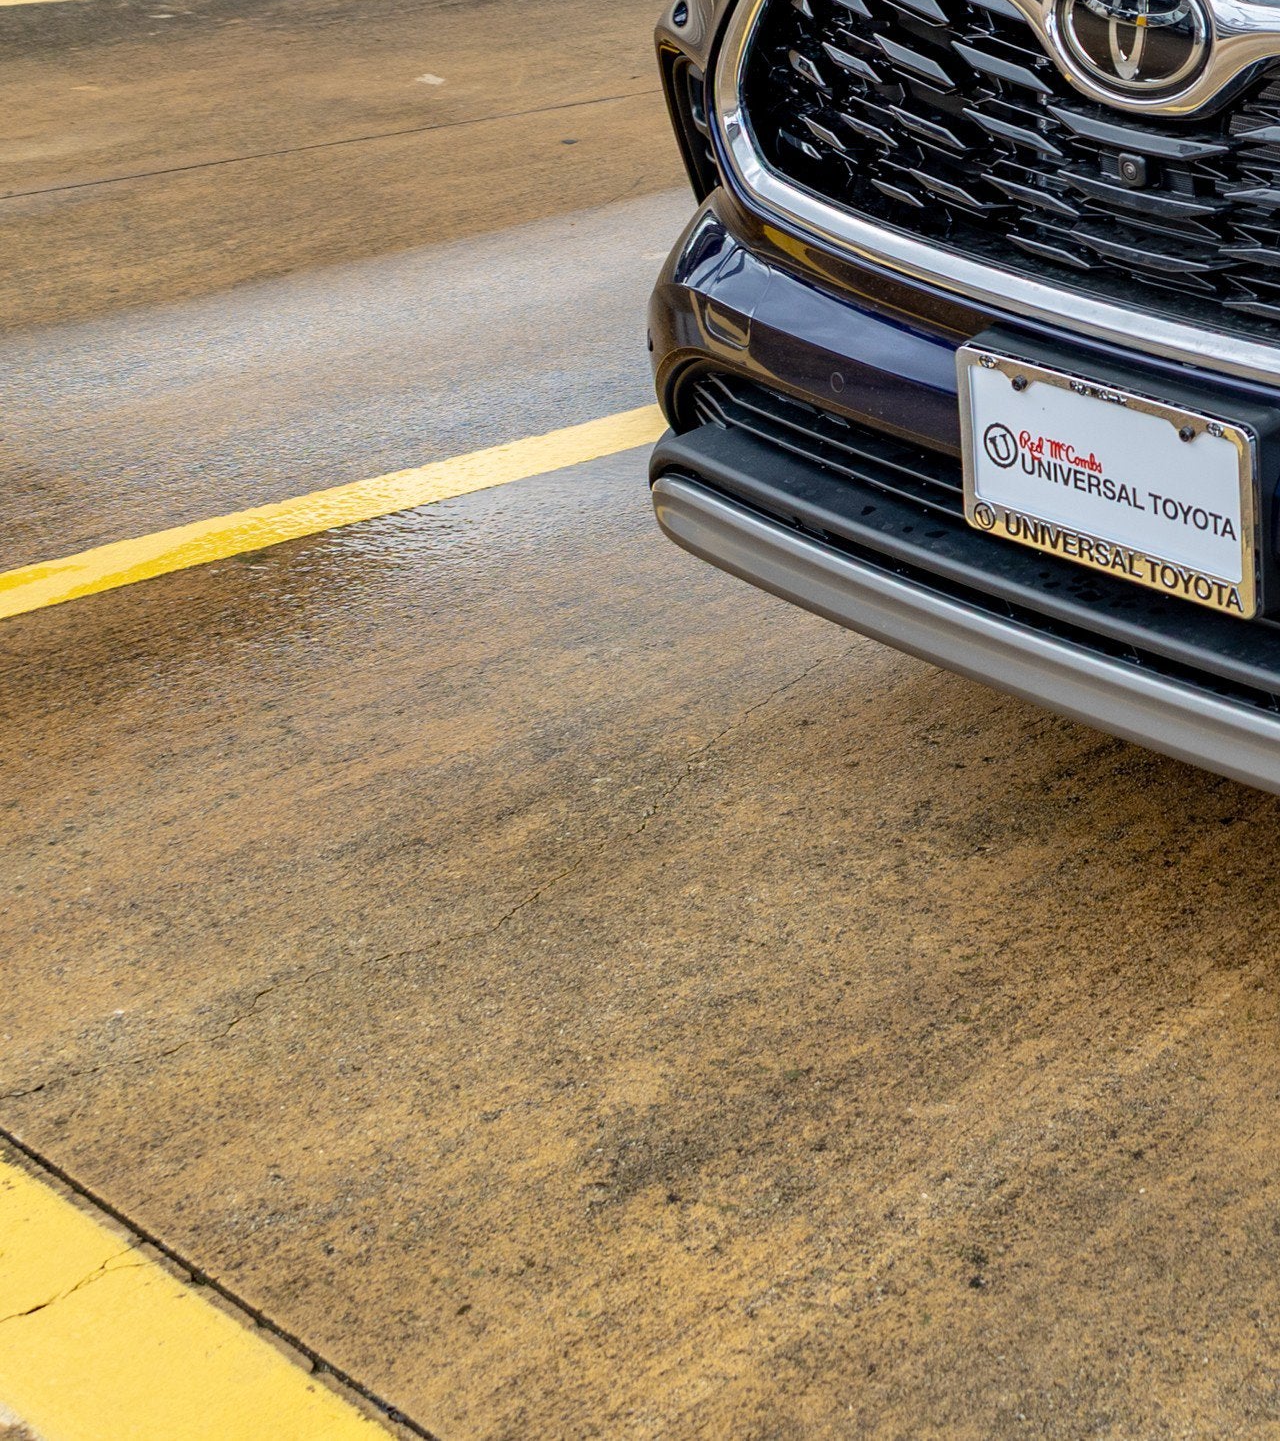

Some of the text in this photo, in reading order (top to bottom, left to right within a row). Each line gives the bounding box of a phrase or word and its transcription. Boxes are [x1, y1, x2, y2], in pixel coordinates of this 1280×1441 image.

[1019, 430, 1045, 462] Red
[1020, 452, 1237, 542] UNIVERSAL TOYOTA
[1004, 510, 1244, 613] UNIVERSAL TOYOTA
